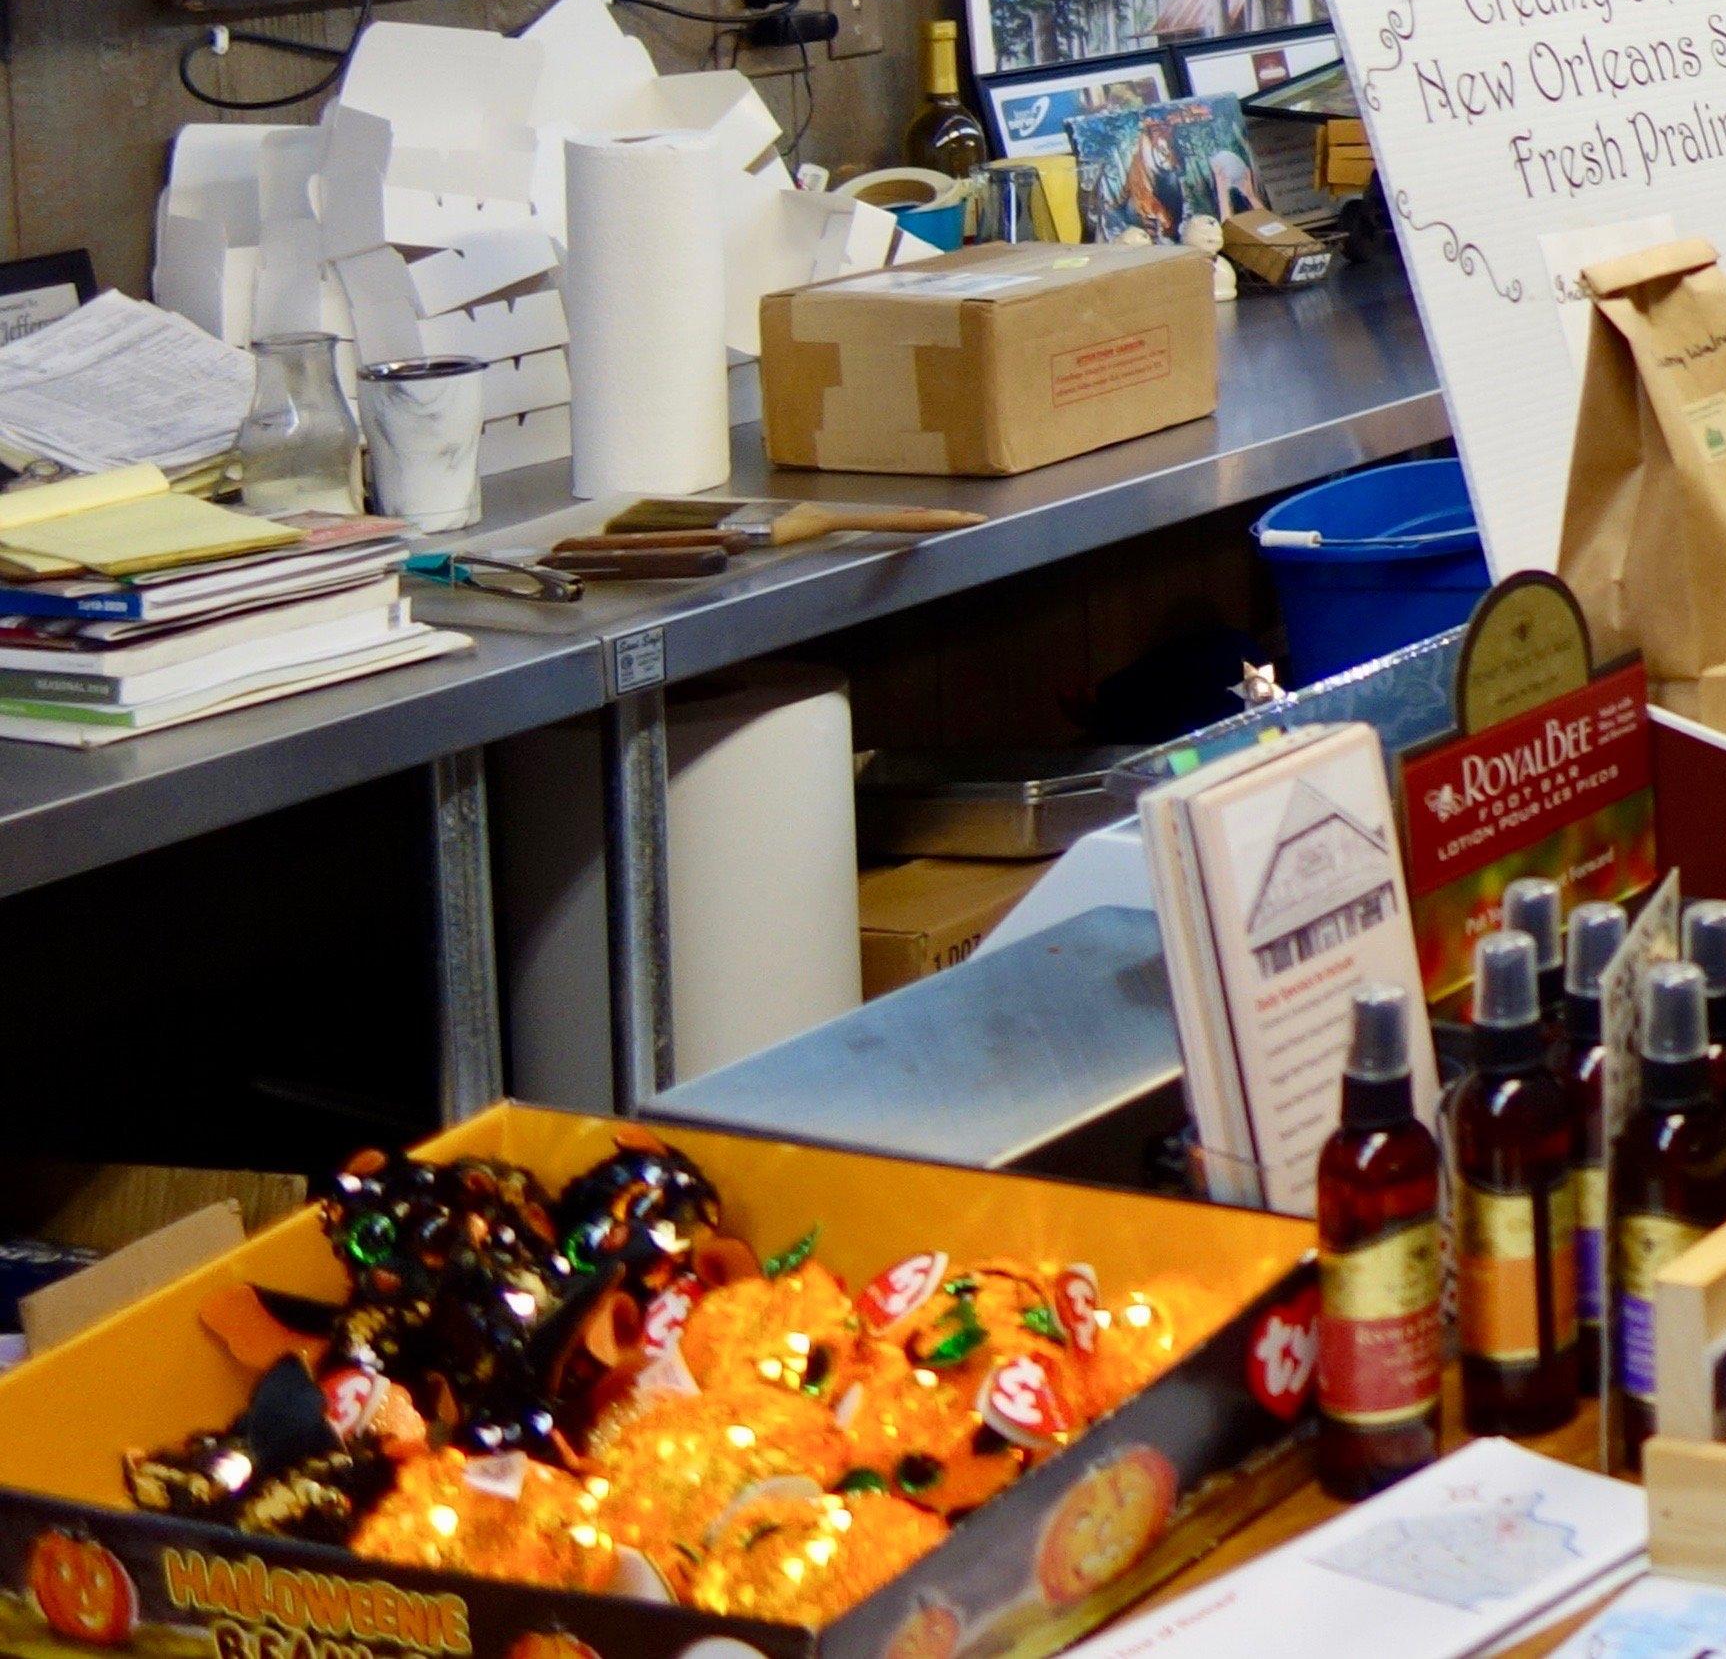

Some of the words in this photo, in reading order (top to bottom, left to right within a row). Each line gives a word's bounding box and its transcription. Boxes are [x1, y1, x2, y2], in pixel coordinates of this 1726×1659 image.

[1413, 58, 1514, 126] New
[1526, 32, 1702, 104] Orleans
[1508, 122, 1627, 199] Fresh
[1437, 825, 1496, 862] LOTION
[1498, 801, 1541, 831] POUR
[1543, 785, 1573, 810] LES
[1575, 763, 1620, 793] PIEDS
[1477, 785, 1533, 822] FOOT
[1539, 764, 1580, 793] BAR
[1254, 1315, 1319, 1397] ty
